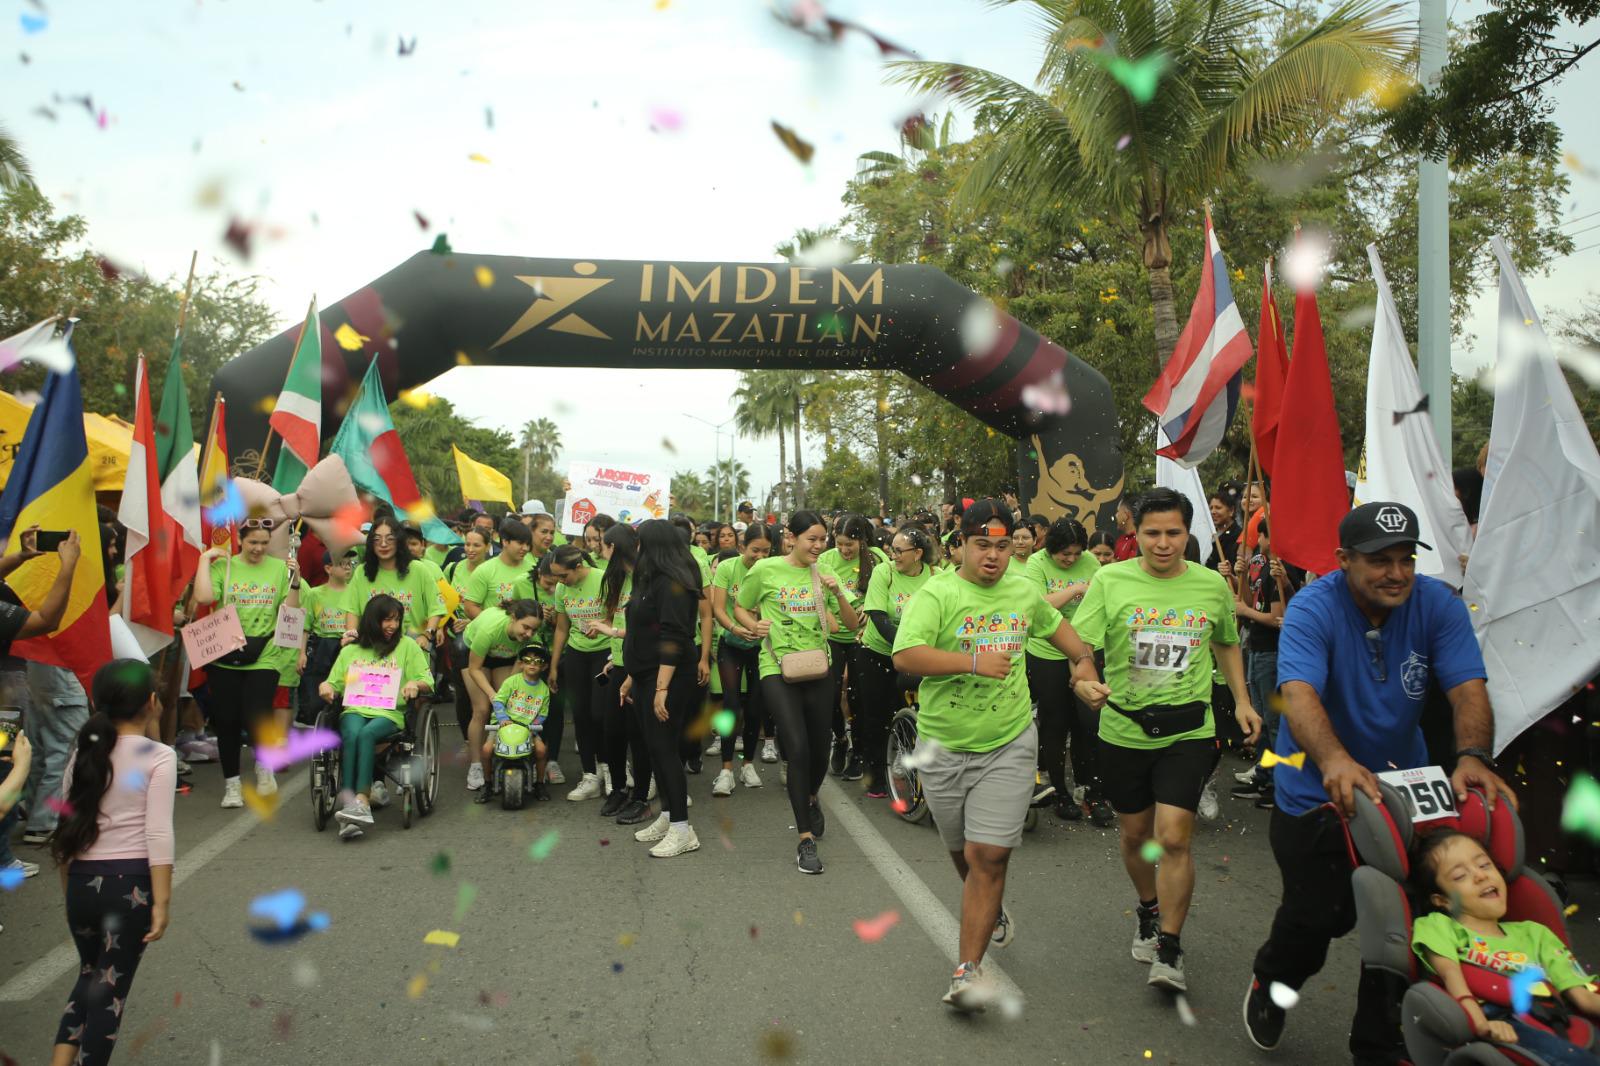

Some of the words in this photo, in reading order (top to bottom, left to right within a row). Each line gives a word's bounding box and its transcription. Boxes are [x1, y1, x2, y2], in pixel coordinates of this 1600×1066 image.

[640, 264, 883, 305] IMDEM
[635, 306, 881, 343] MAZATLÁN
[632, 347, 706, 358] INSTITUTO
[710, 348, 784, 358] MUNICIPAL
[1138, 642, 1188, 669] 787
